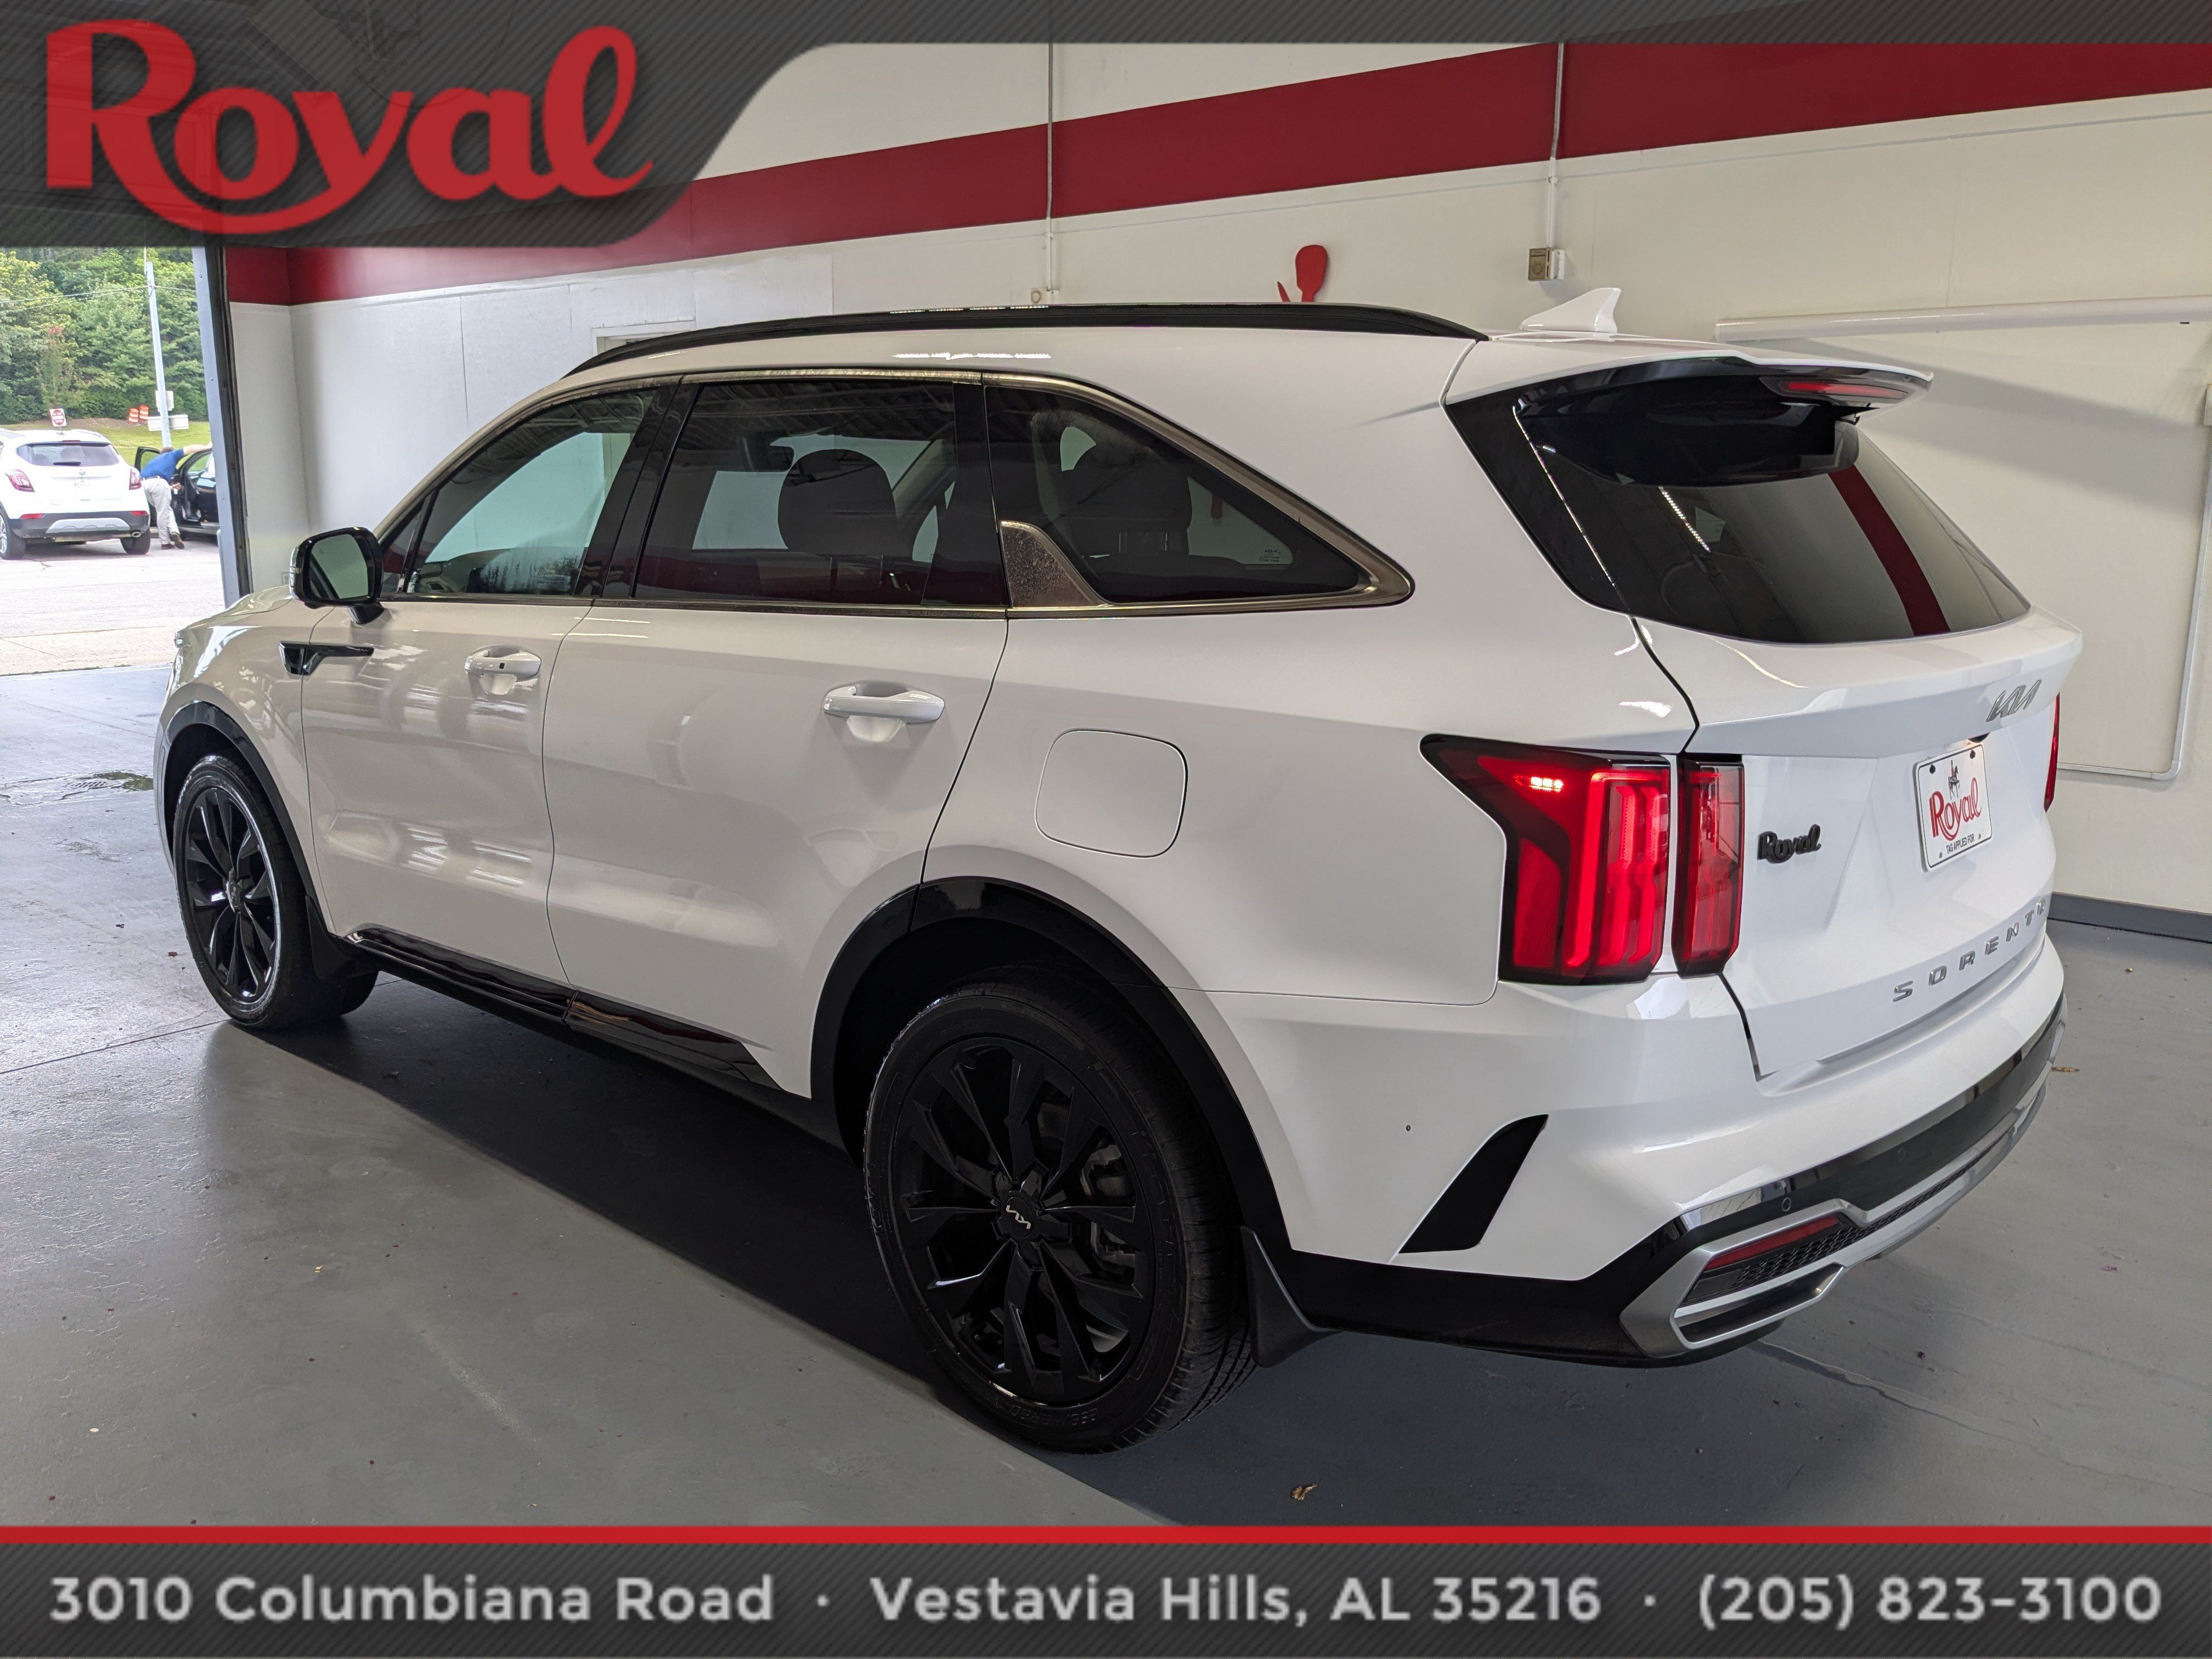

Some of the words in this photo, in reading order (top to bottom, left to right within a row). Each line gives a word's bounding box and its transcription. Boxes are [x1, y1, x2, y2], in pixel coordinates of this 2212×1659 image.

[1929, 777, 1982, 841] Royal
[1757, 823, 1822, 864] Royal
[1954, 837, 1967, 850] APPLIED
[1893, 898, 2046, 1002] SORENTO
